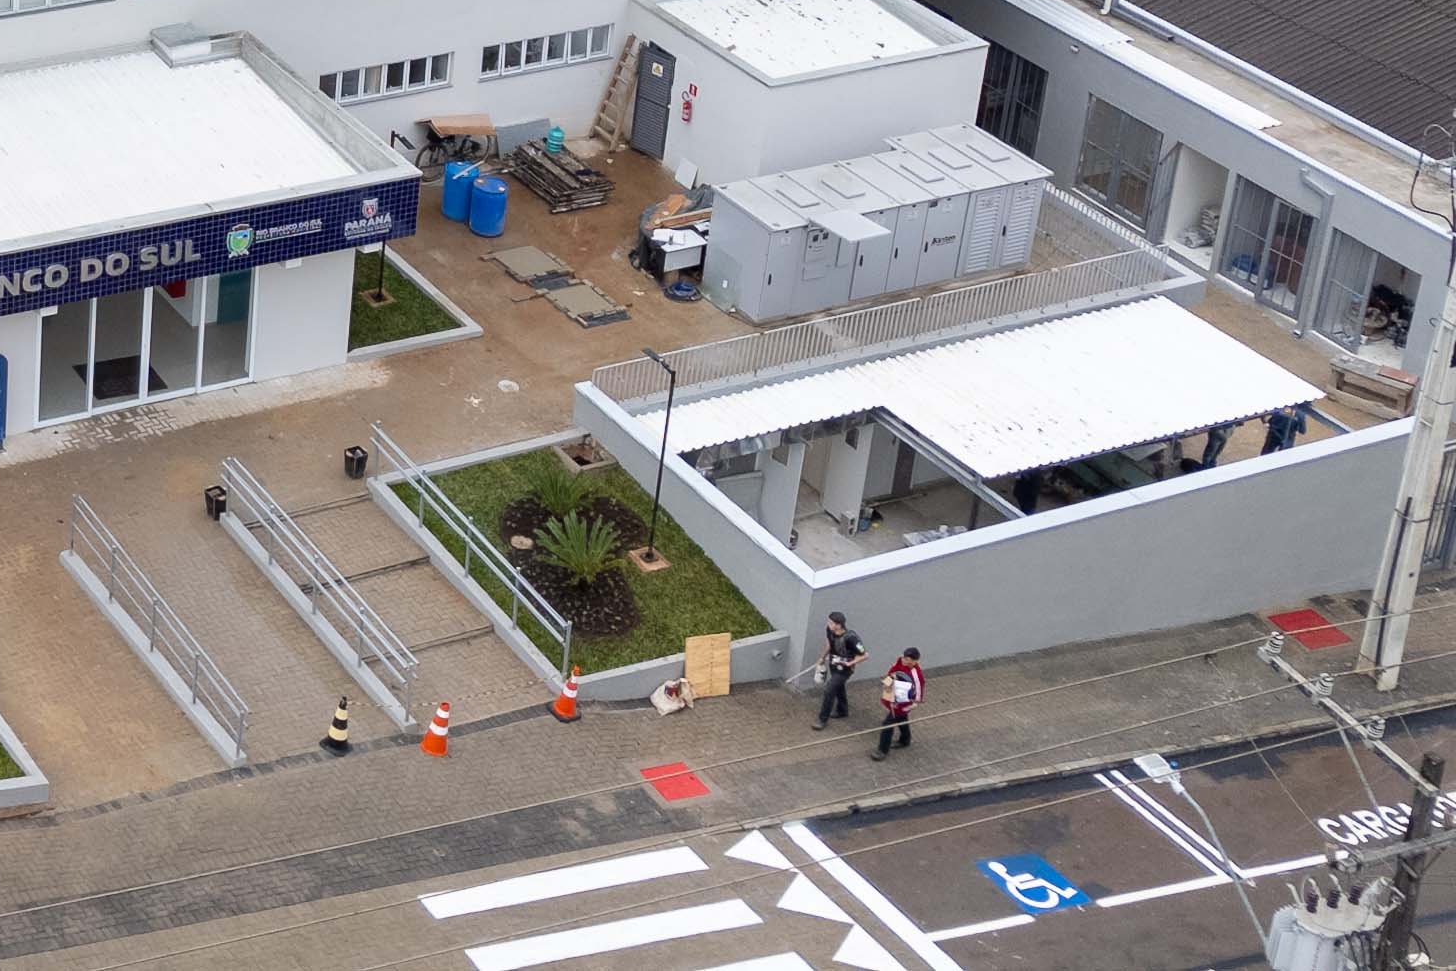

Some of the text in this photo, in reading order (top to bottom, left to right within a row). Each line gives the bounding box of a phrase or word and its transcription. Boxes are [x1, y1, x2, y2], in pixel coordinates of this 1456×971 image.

[345, 212, 392, 231] PARANÁ
[80, 251, 130, 282] DO
[140, 238, 202, 271] SUL
[1317, 802, 1413, 846] CARG
